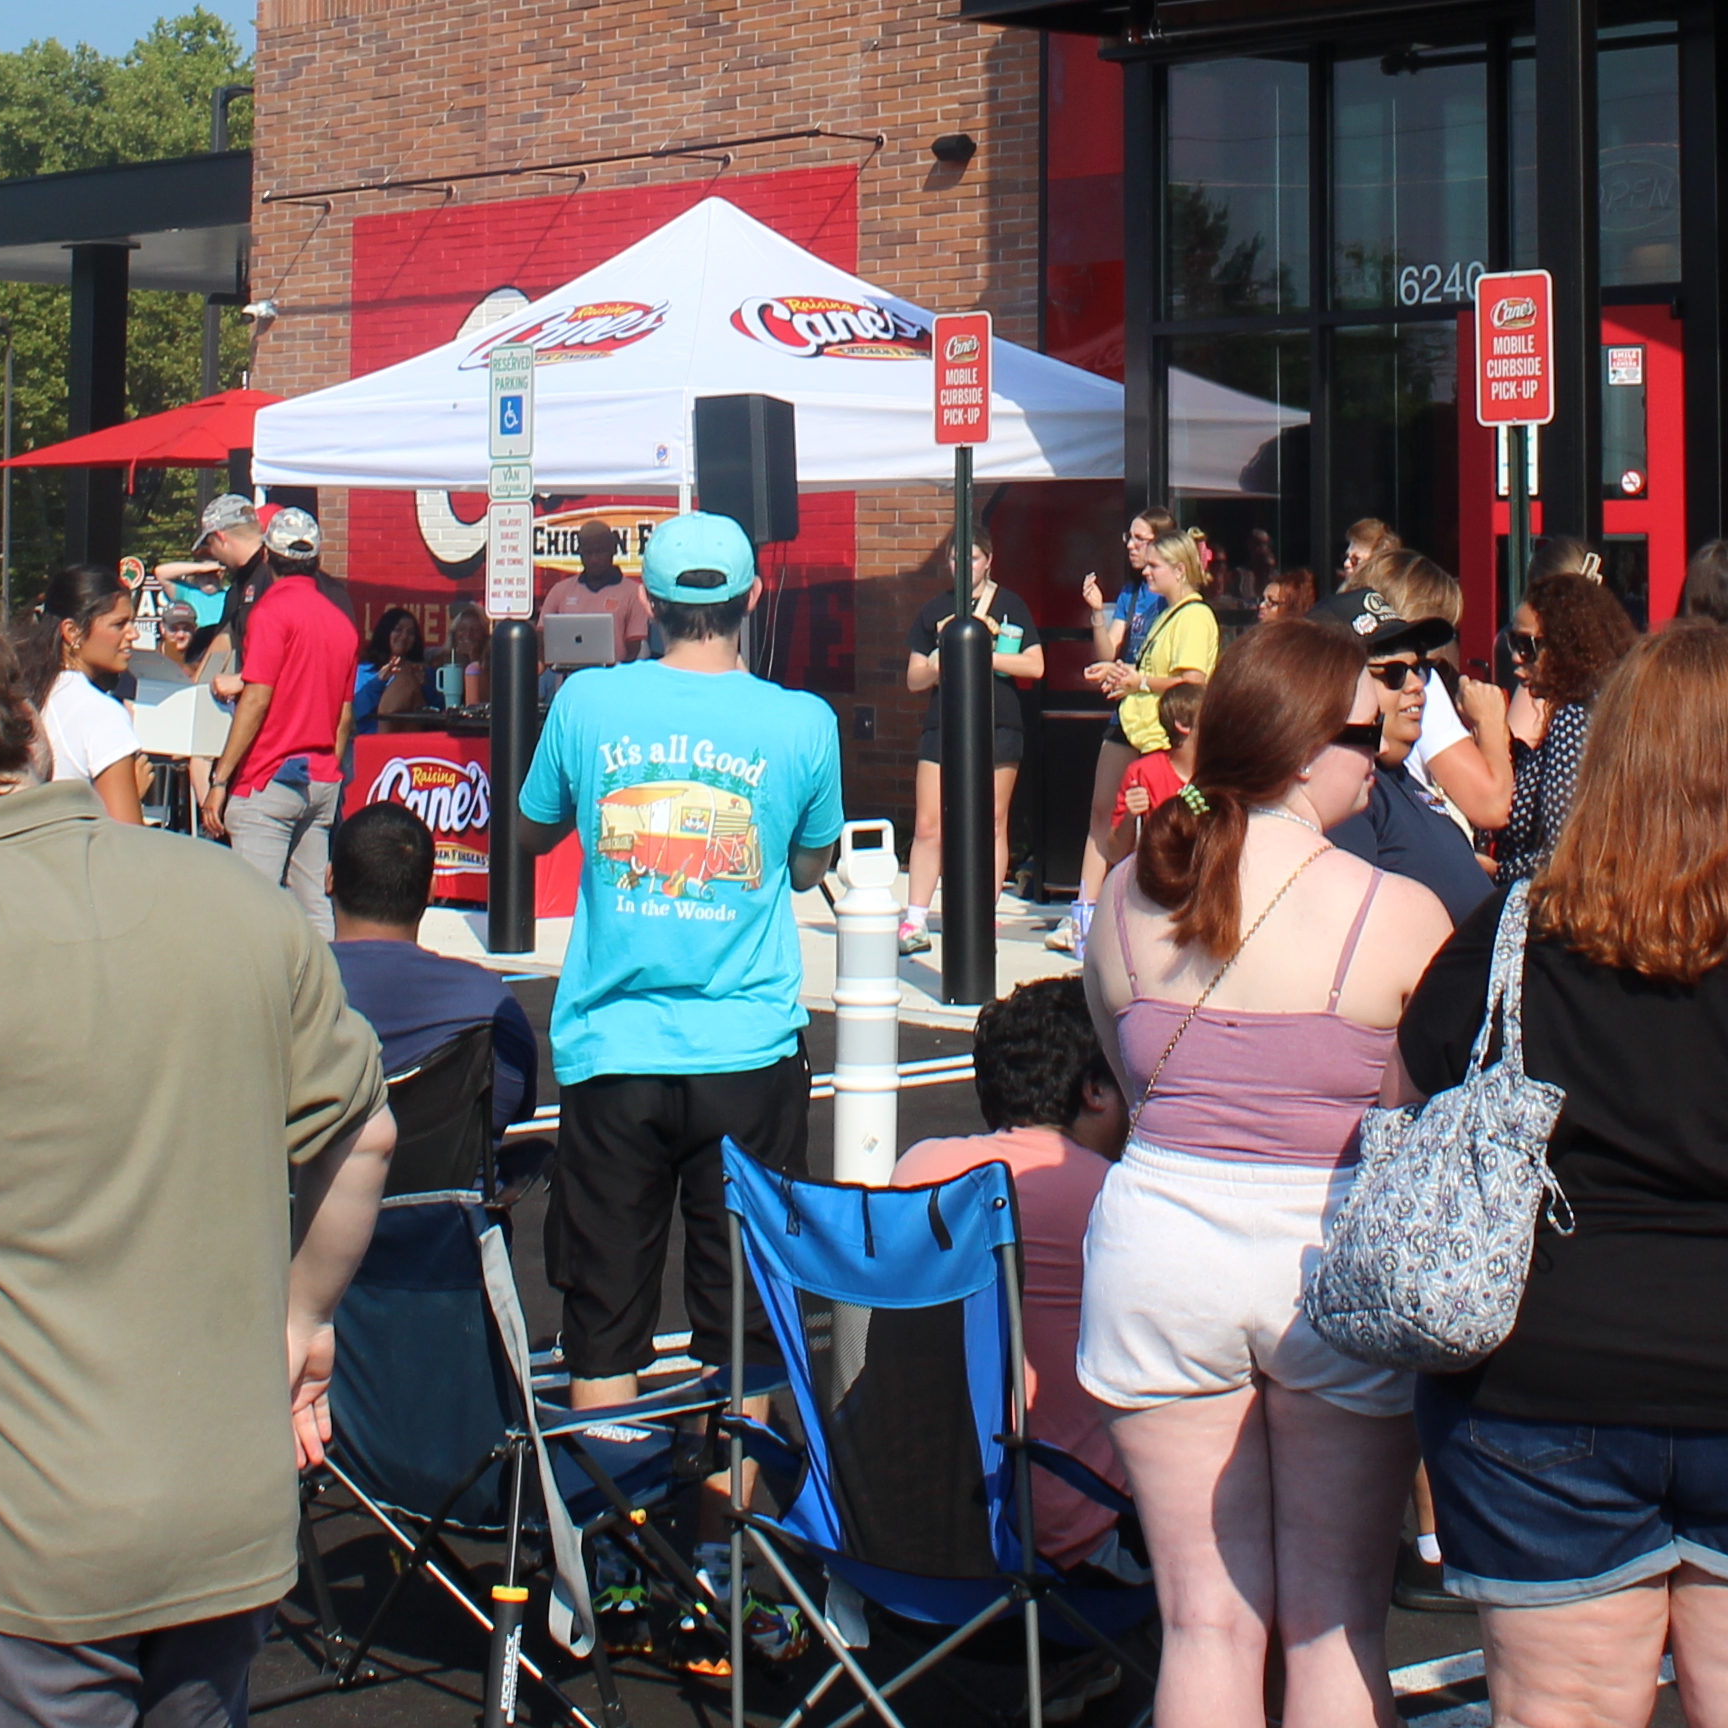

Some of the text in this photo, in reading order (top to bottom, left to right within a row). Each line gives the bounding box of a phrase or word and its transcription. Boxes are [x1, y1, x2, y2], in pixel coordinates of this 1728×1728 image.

[1400, 261, 1485, 305] 6240
[784, 298, 854, 313] Raising
[1493, 297, 1535, 328] Cane's
[741, 295, 922, 357] Cane's
[945, 335, 978, 361] Cane's
[1493, 335, 1535, 355] MOBILE
[493, 355, 531, 372] RESERVED
[1486, 357, 1542, 379] CURBSIDE
[494, 375, 529, 391] PARKING
[945, 367, 978, 385] MOBILE
[940, 387, 983, 406] CURBSIDE
[1491, 380, 1538, 400] PICK-UP
[943, 407, 980, 425] PICK-UP
[503, 470, 520, 482] VAN
[508, 544, 519, 553] FINE
[532, 525, 628, 556] CHICN
[600, 734, 767, 787] It's all Good
[412, 766, 456, 788] Raising
[616, 895, 737, 922] In the Woods
